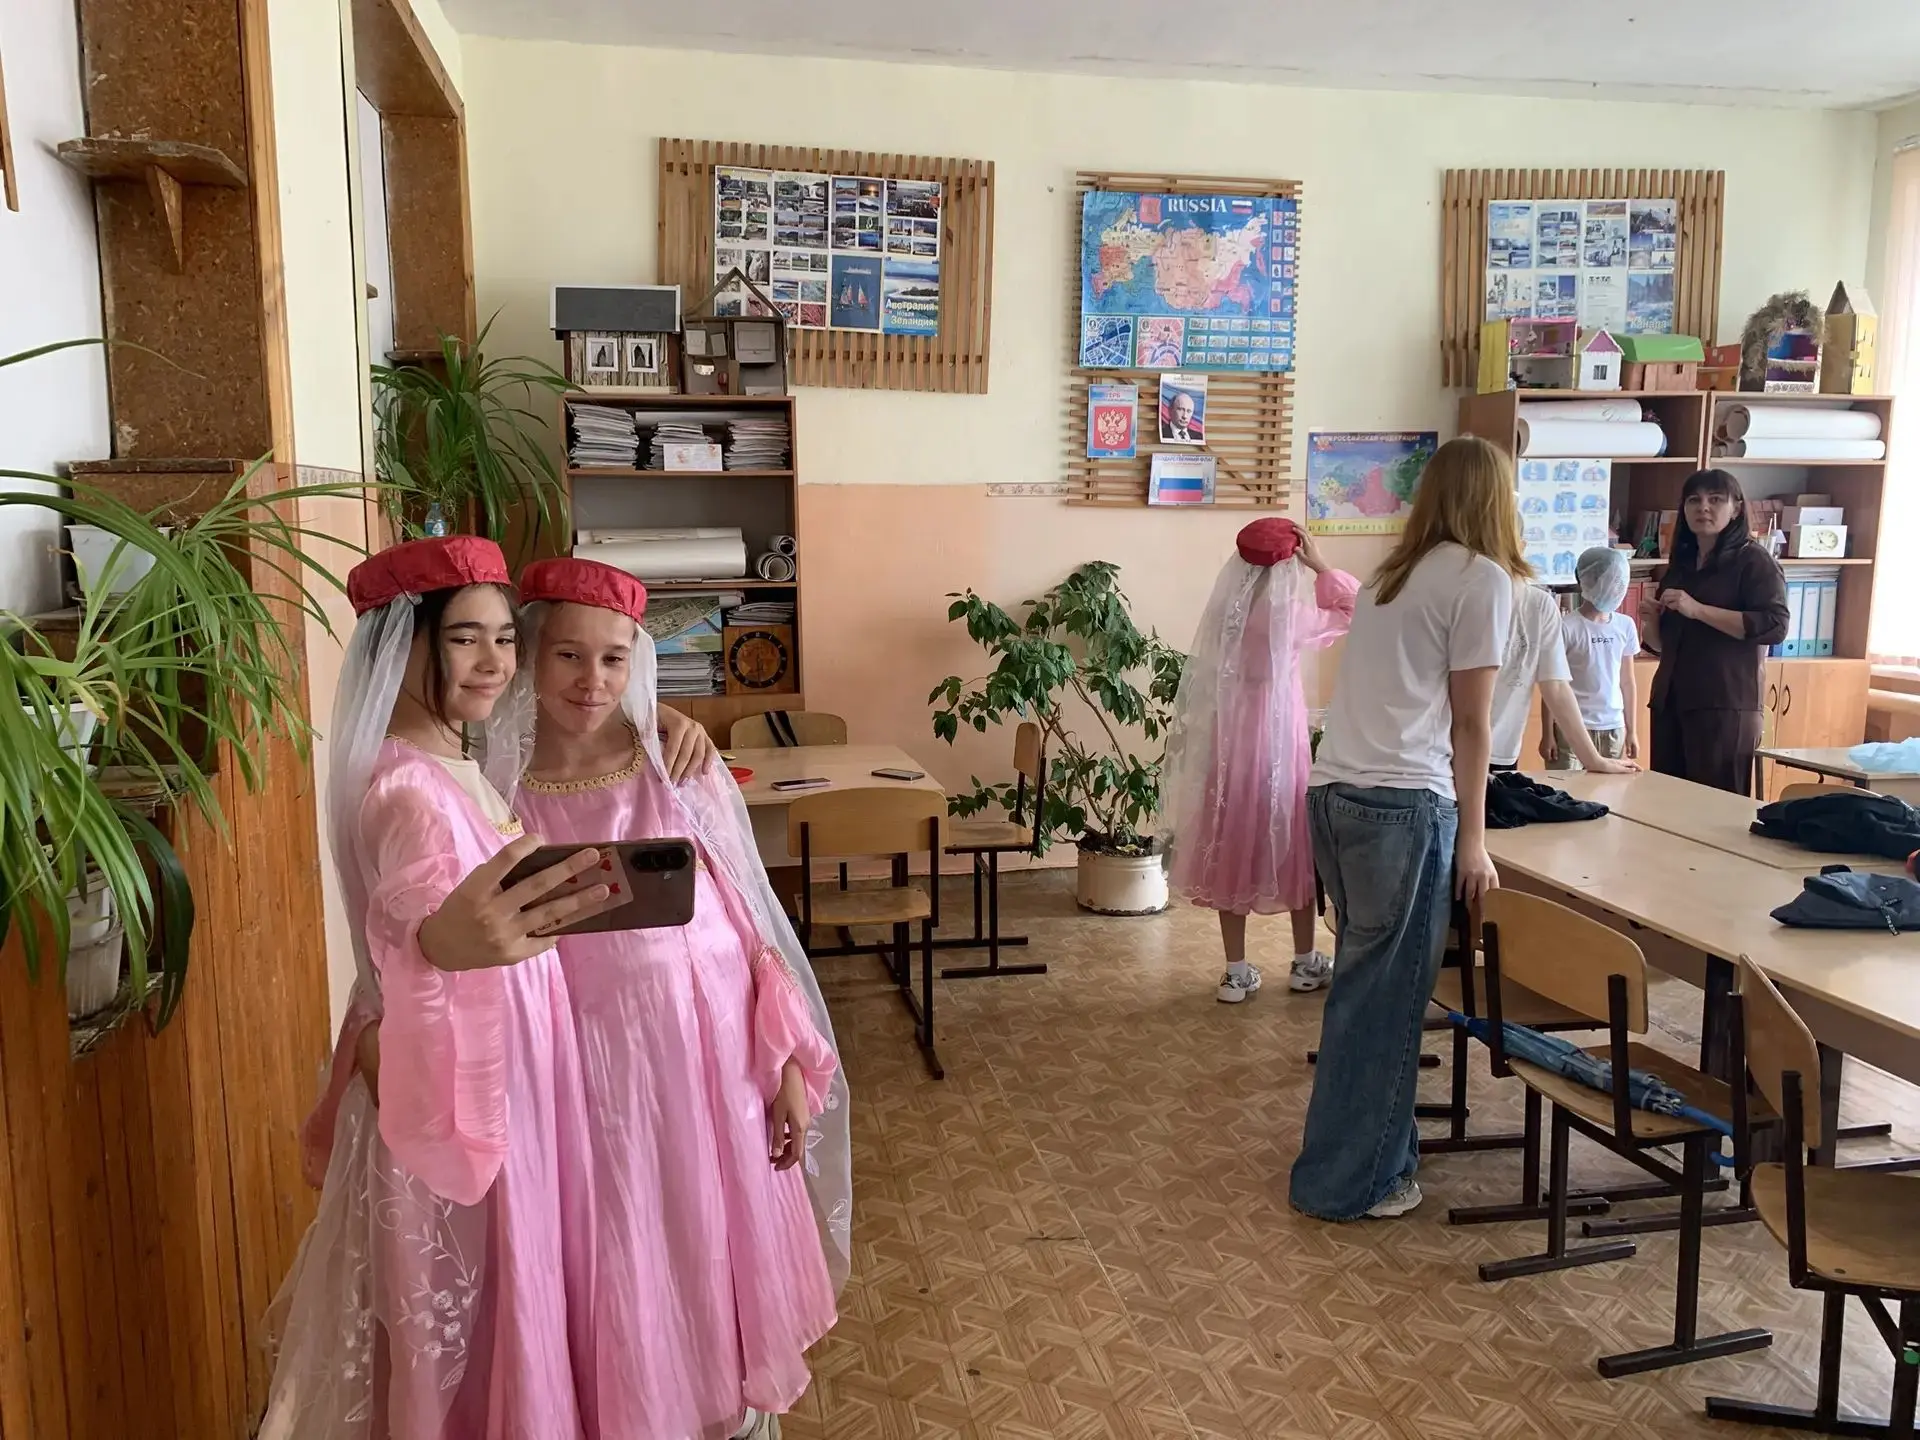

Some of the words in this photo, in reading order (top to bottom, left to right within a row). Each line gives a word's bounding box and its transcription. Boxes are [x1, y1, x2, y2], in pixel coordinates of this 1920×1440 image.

[1168, 198, 1228, 213] RUSSIA
[886, 298, 935, 311] Австралия
[890, 315, 934, 327] Зеландия
[1630, 318, 1667, 329] Канада
